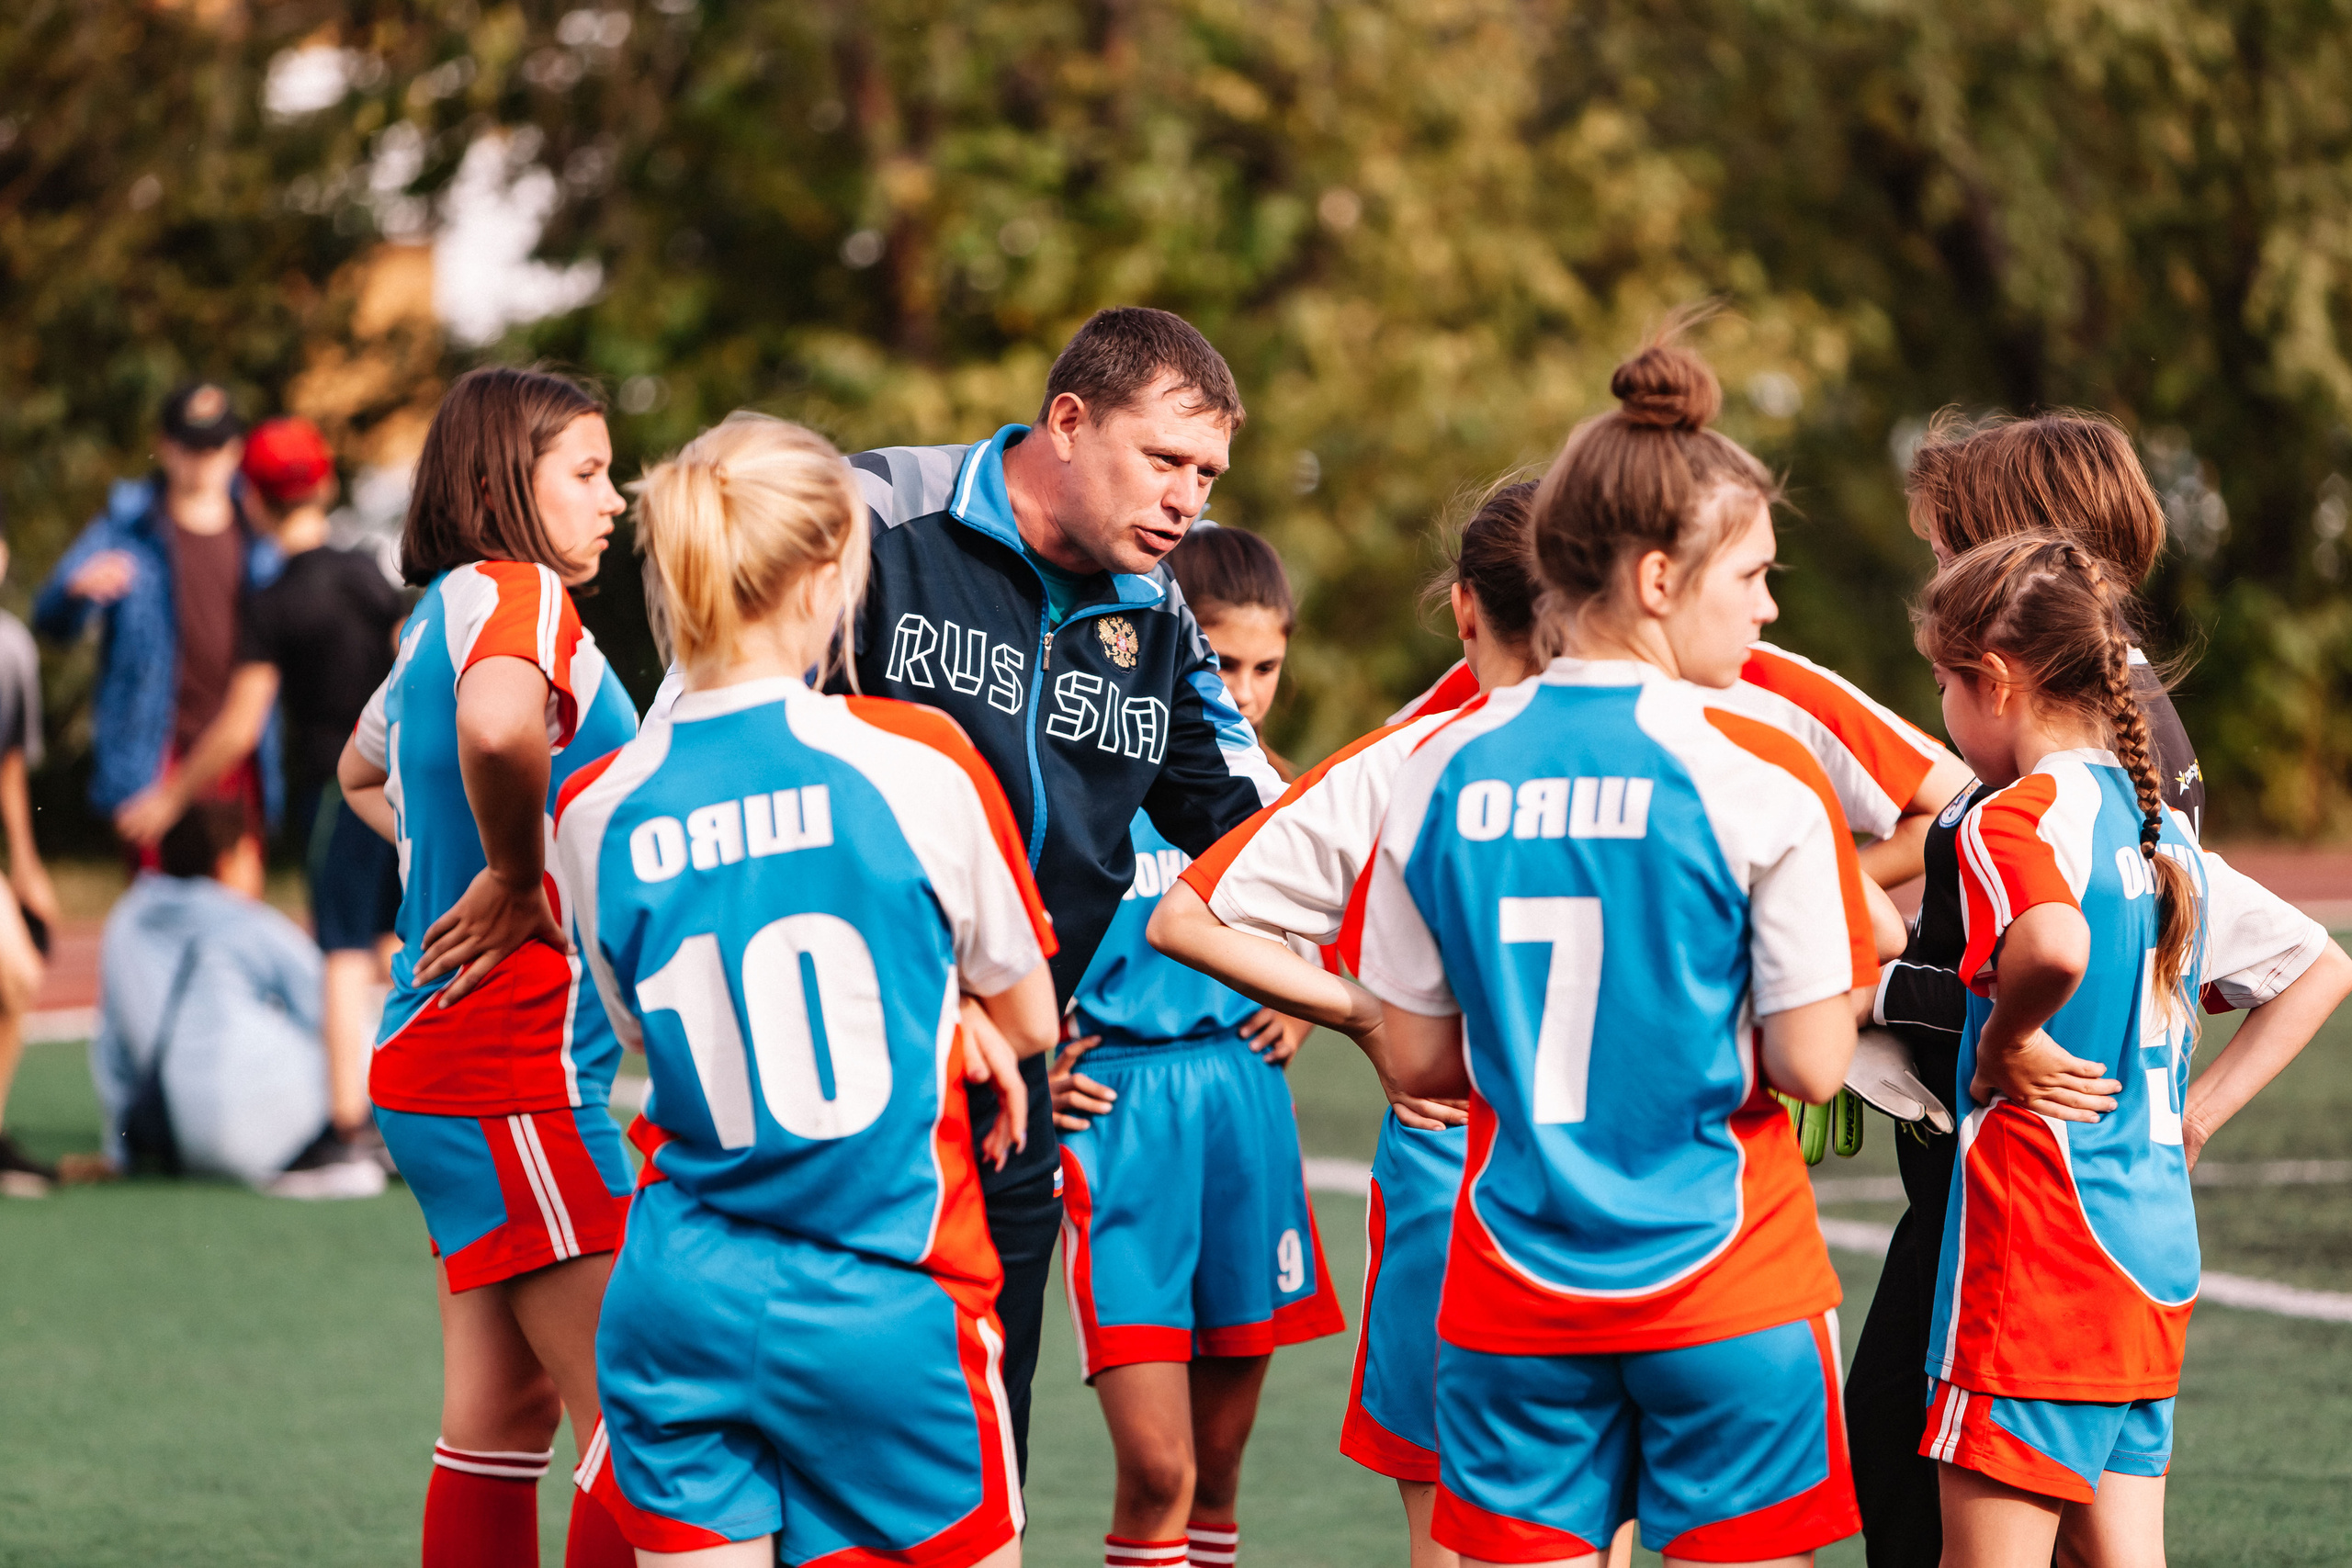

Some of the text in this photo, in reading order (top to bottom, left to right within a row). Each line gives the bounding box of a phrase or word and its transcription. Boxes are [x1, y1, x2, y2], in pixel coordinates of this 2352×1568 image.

[635, 912, 893, 1150] 10
[1498, 897, 1604, 1124] 7
[1846, 1093, 1855, 1148] DEMIX
[1276, 1228, 1305, 1292] 9
